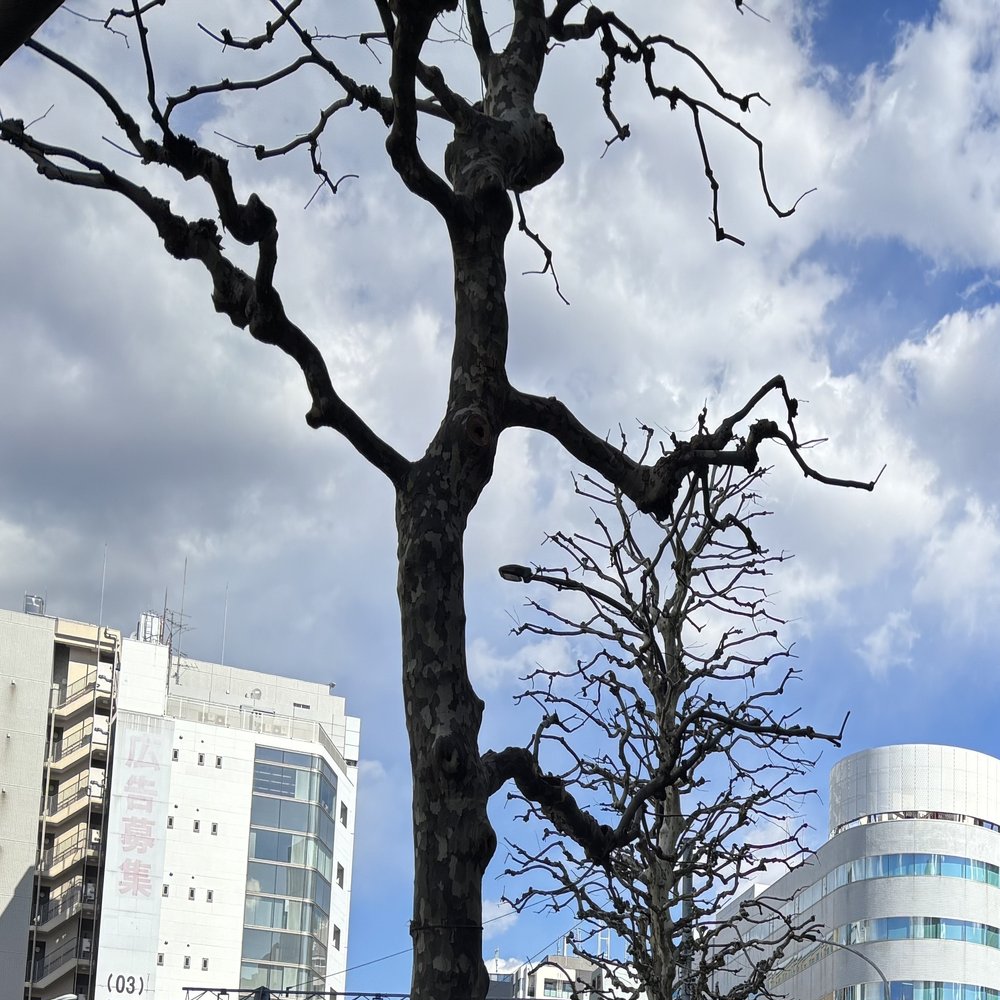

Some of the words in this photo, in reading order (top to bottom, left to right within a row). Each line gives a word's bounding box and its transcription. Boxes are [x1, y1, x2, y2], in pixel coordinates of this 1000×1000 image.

[119, 735, 161, 898] 広告募集
[106, 976, 144, 996] (03)
